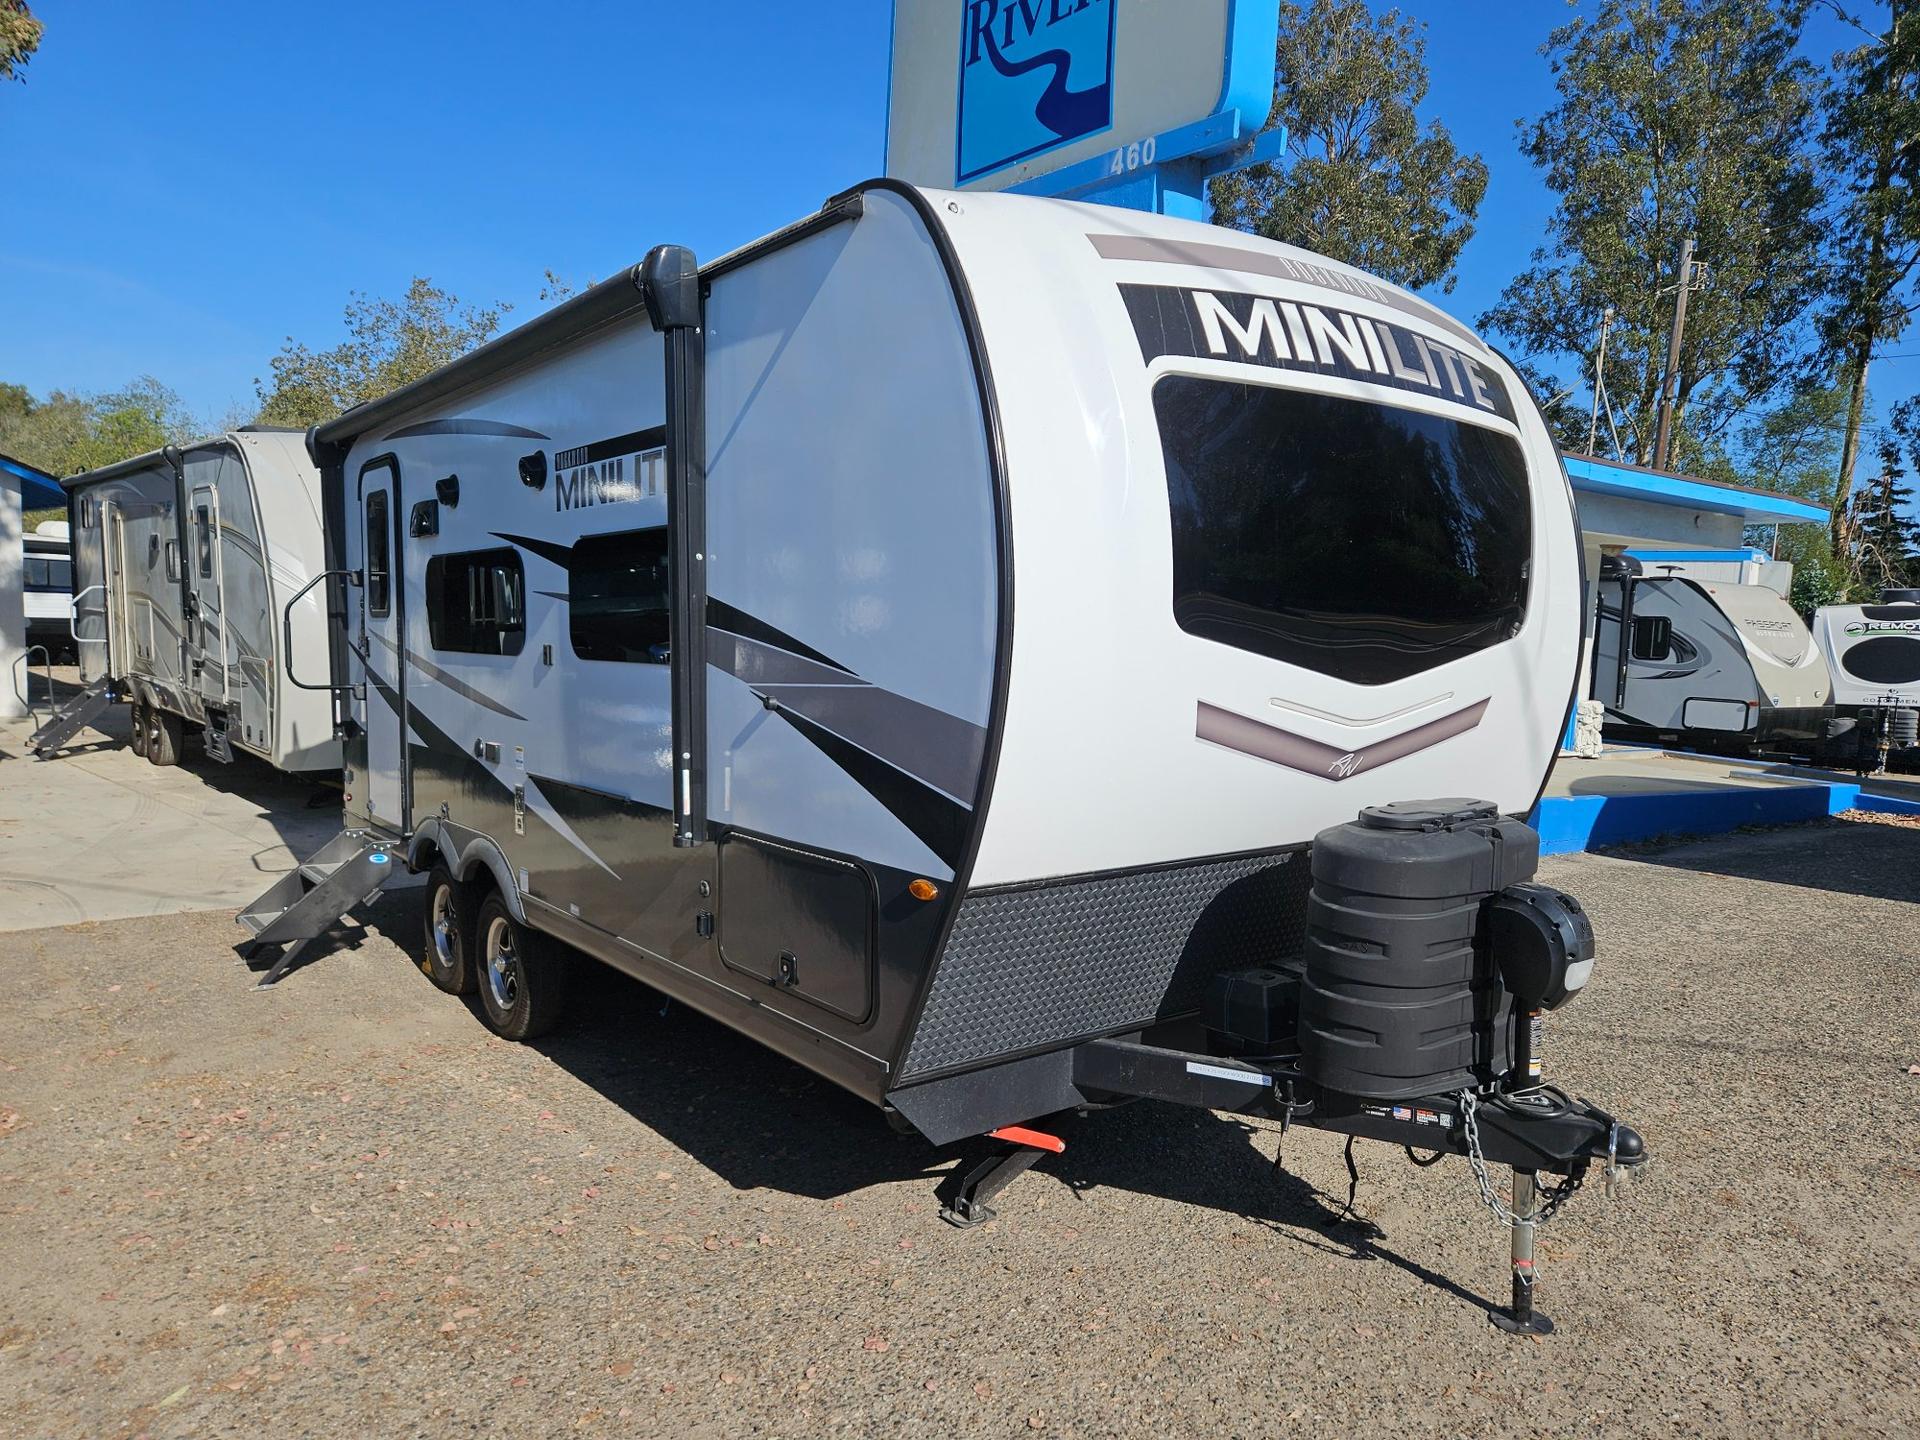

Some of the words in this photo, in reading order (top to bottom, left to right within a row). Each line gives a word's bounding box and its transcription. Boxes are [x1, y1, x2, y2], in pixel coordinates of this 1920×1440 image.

[965, 0, 1104, 67] RIVE
[1111, 137, 1155, 175] 460
[1279, 256, 1389, 304] ROCKWOOD
[556, 448, 667, 512] MINILIT
